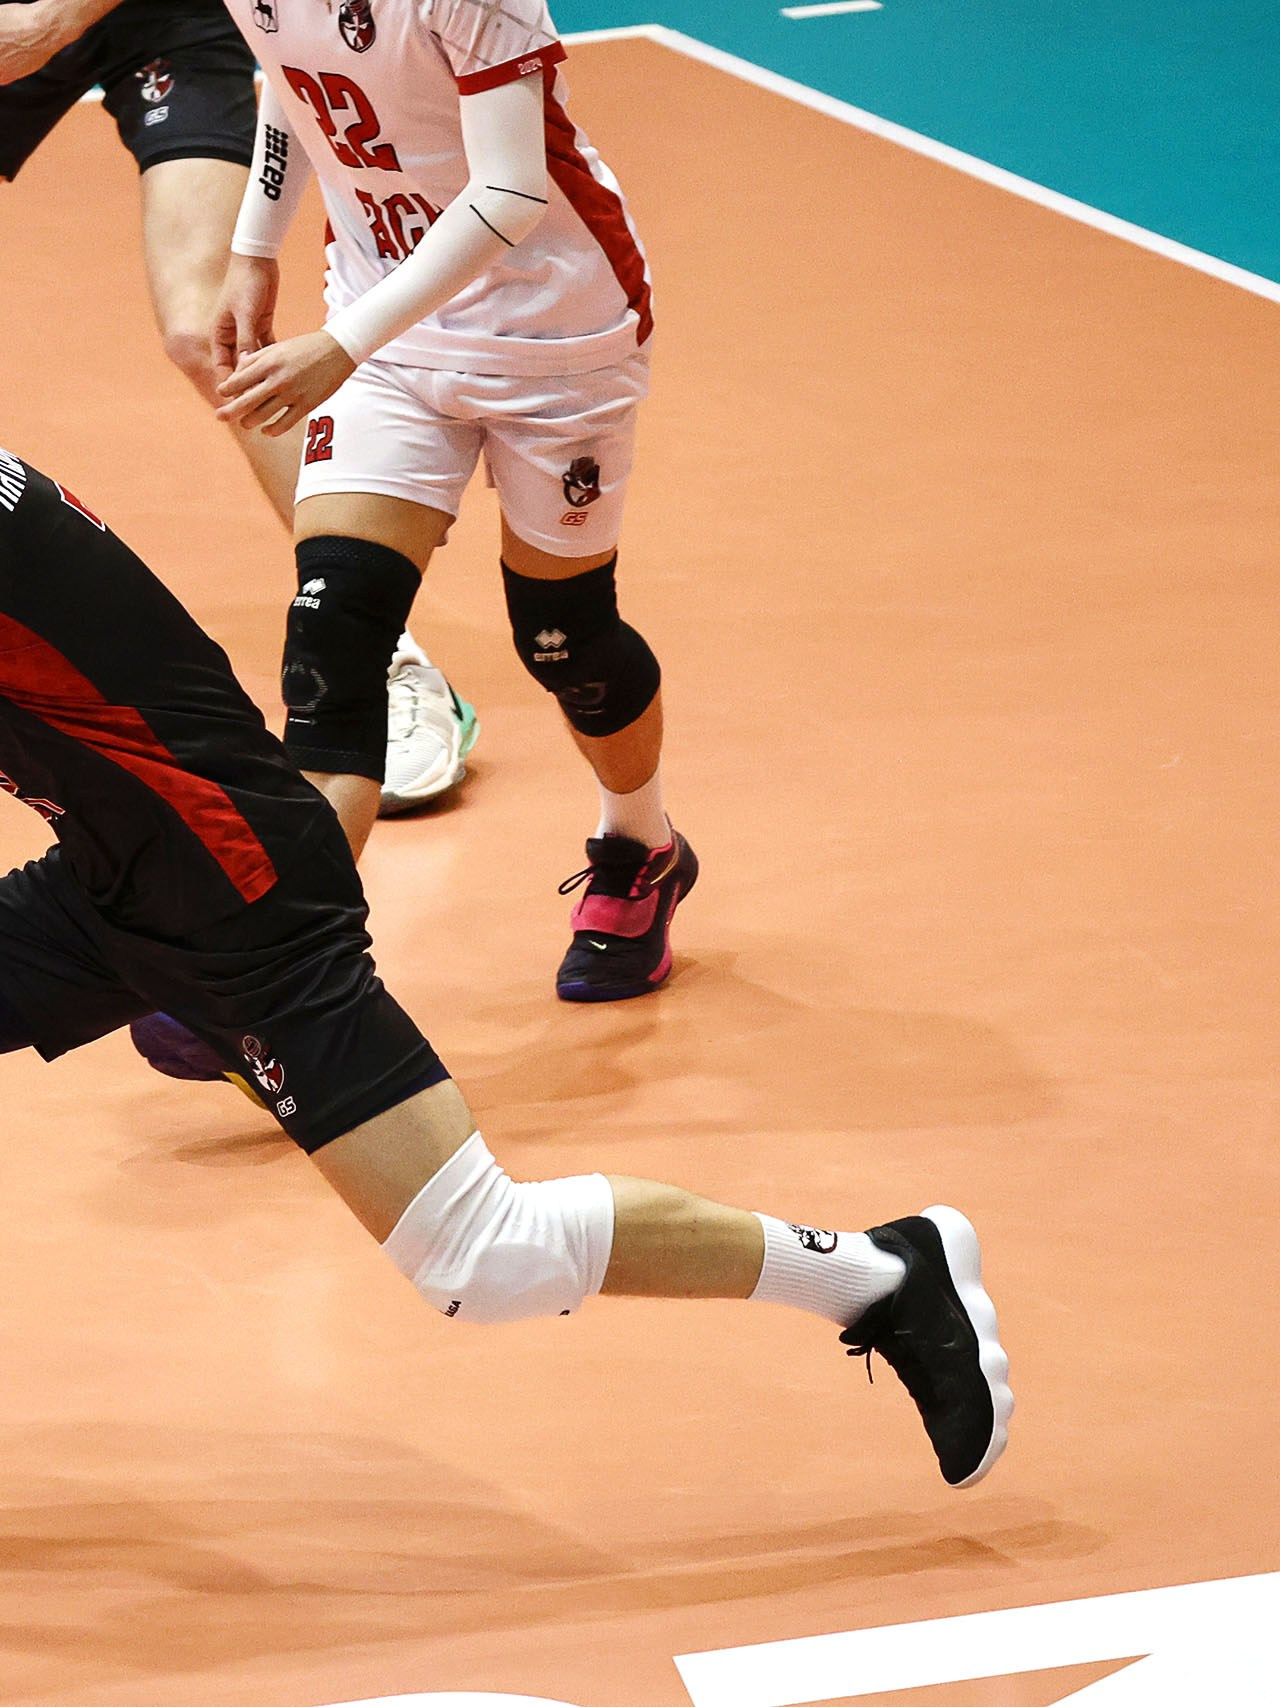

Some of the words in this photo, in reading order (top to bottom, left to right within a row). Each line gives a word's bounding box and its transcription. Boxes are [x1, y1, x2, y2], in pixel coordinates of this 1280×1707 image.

[280, 64, 403, 173] 22
[258, 150, 287, 201] cep
[304, 415, 335, 466] 22
[560, 511, 589, 526] GS
[276, 1096, 297, 1118] GS
